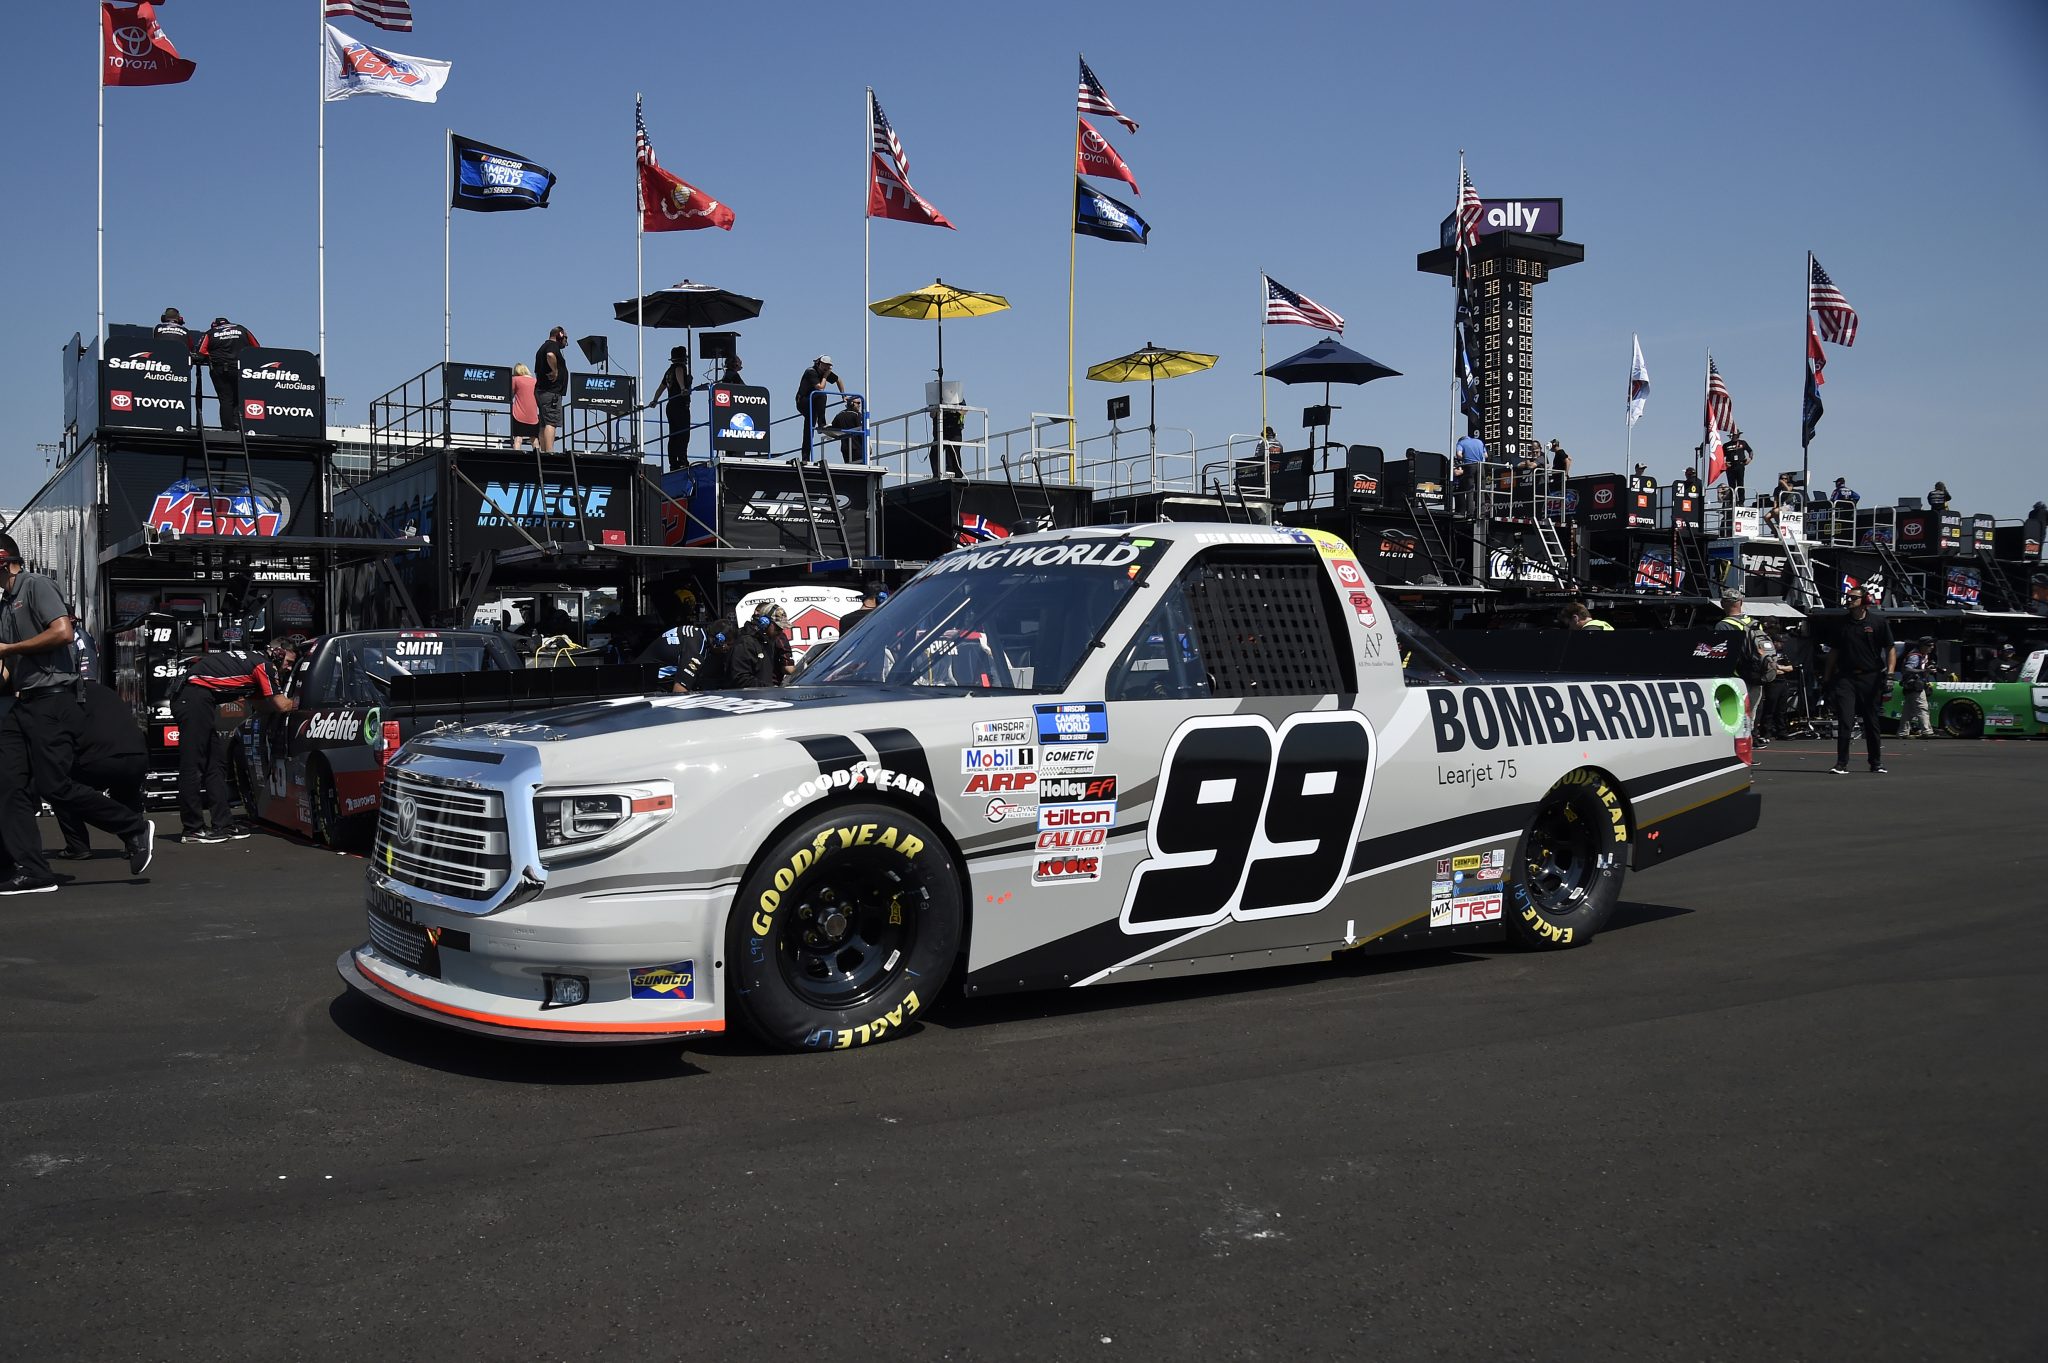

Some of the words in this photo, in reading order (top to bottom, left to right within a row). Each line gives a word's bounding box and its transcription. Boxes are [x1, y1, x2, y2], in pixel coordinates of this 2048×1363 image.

[109, 56, 157, 69] TOYOTA
[491, 157, 522, 169] NASCAR
[1488, 202, 1540, 232] ally
[1507, 301, 1513, 311] 2
[1507, 318, 1513, 329] 3
[214, 329, 242, 338] Safelite
[1507, 337, 1514, 346] 4
[109, 357, 172, 373] Safelite
[1507, 354, 1513, 364] 5
[144, 372, 188, 383] AutoGlass
[241, 368, 301, 381] Safelite
[463, 368, 496, 380] NIECE
[1507, 372, 1514, 382] 6
[274, 381, 315, 391] AutoGlass
[585, 377, 616, 389] NIECE
[591, 397, 624, 405] CHEVROLET
[733, 395, 767, 405] TOYOTA
[1507, 390, 1514, 400] 7
[134, 397, 185, 410] TOYOTA
[266, 405, 314, 418] TOYOTA
[1507, 408, 1514, 418] 8
[722, 429, 755, 439] HALMAR
[1507, 426, 1514, 436] 9
[1505, 444, 1516, 454] 10
[1353, 480, 1377, 490] GMS
[480, 482, 612, 518] NIECE
[148, 492, 281, 537] KBM
[1589, 512, 1617, 521] TOYOTA
[1736, 510, 1757, 519] HRE
[1782, 514, 1802, 522] HRE
[1003, 544, 1140, 567] WORLD
[1379, 551, 1414, 559] RACING
[1742, 555, 1788, 572] HRE
[254, 572, 311, 581] EATHERLITE
[153, 628, 171, 642] 18
[395, 641, 443, 656] SMITH
[1936, 681, 1995, 690] SUNBELT
[1055, 713, 1090, 723] CAMPING
[1427, 681, 1712, 753] BOMBARDIER
[306, 710, 361, 741] Safelite
[992, 721, 1024, 732] NASCAR
[1056, 722, 1090, 733] WORLD
[978, 734, 998, 742] RACE
[1000, 733, 1026, 741] TRUCK
[966, 748, 1013, 768] Mobil
[1045, 750, 1095, 762] COMETIC
[1438, 763, 1493, 788] Learjet
[1497, 759, 1518, 779] 75
[782, 762, 925, 807] GOODYEAR
[964, 772, 1037, 793] ARP
[1040, 780, 1086, 800] Holley
[1044, 809, 1110, 827] tilton
[1119, 710, 1378, 936] 99
[1038, 829, 1106, 848] CALICO
[1038, 857, 1099, 876] KOOKS
[1454, 856, 1479, 867] CHAMPION
[752, 824, 925, 936] GOODYEAR
[370, 886, 413, 923] TUNDRA
[1432, 900, 1451, 918] WIX
[1454, 899, 1501, 922] TRD
[1522, 905, 1574, 944] EAGLE
[634, 973, 692, 987] SUNOCO
[833, 989, 922, 1050] EAGLE
